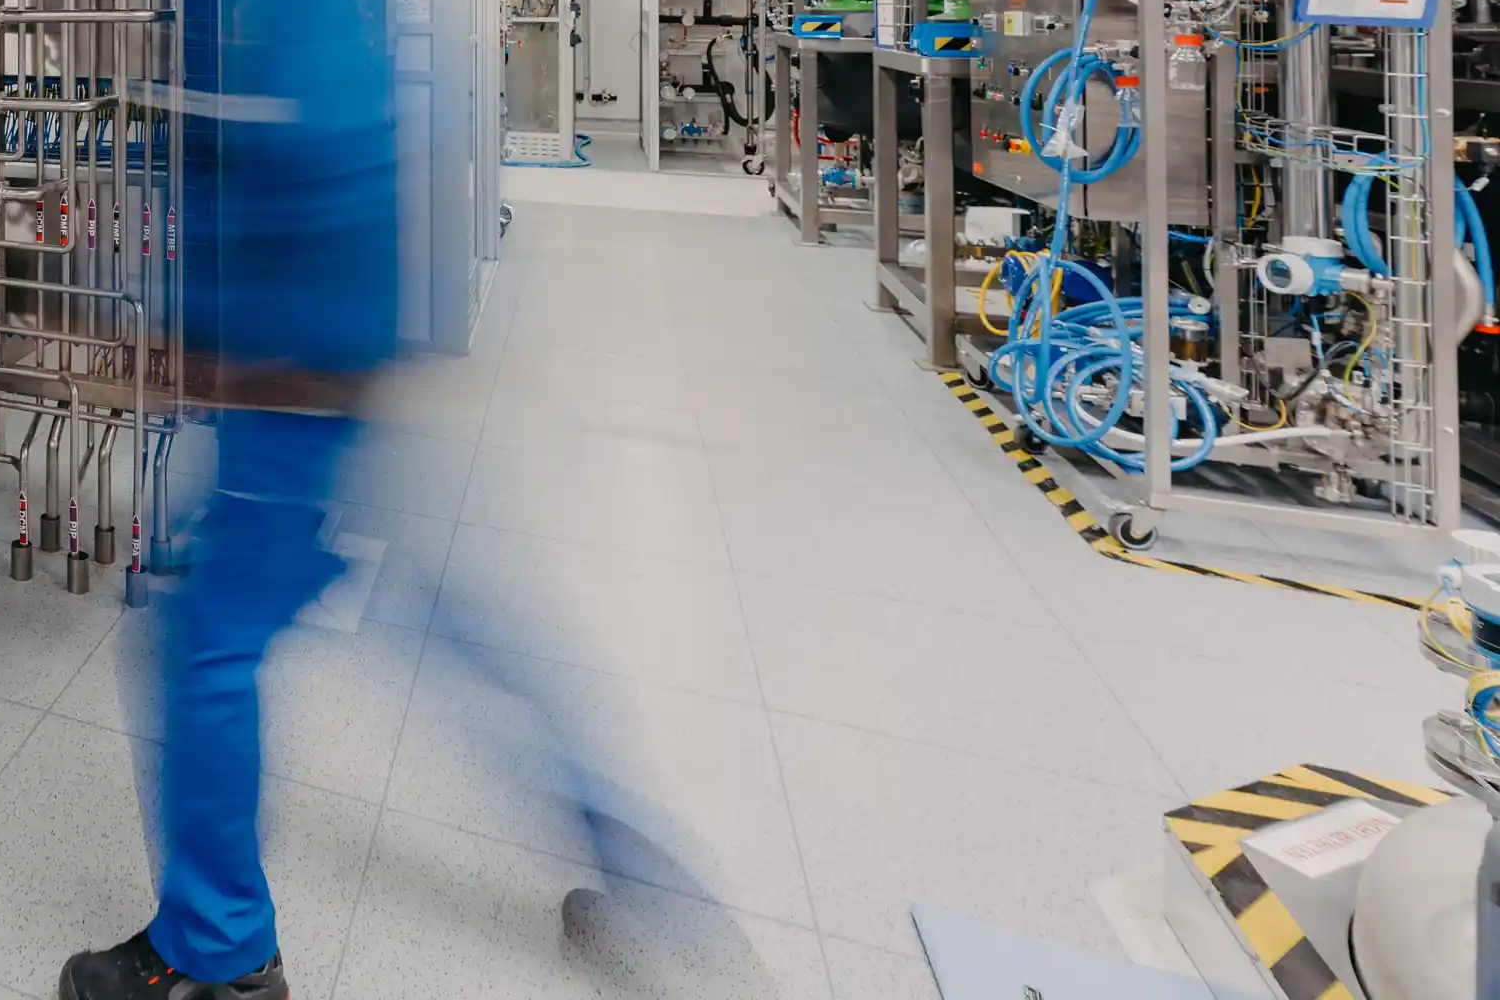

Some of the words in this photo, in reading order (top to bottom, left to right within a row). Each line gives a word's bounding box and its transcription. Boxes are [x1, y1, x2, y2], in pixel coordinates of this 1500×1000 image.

[167, 224, 176, 251] MTBE
[19, 510, 27, 534] DCM
[69, 521, 77, 539] PIP
[132, 539, 140, 557] IPA
